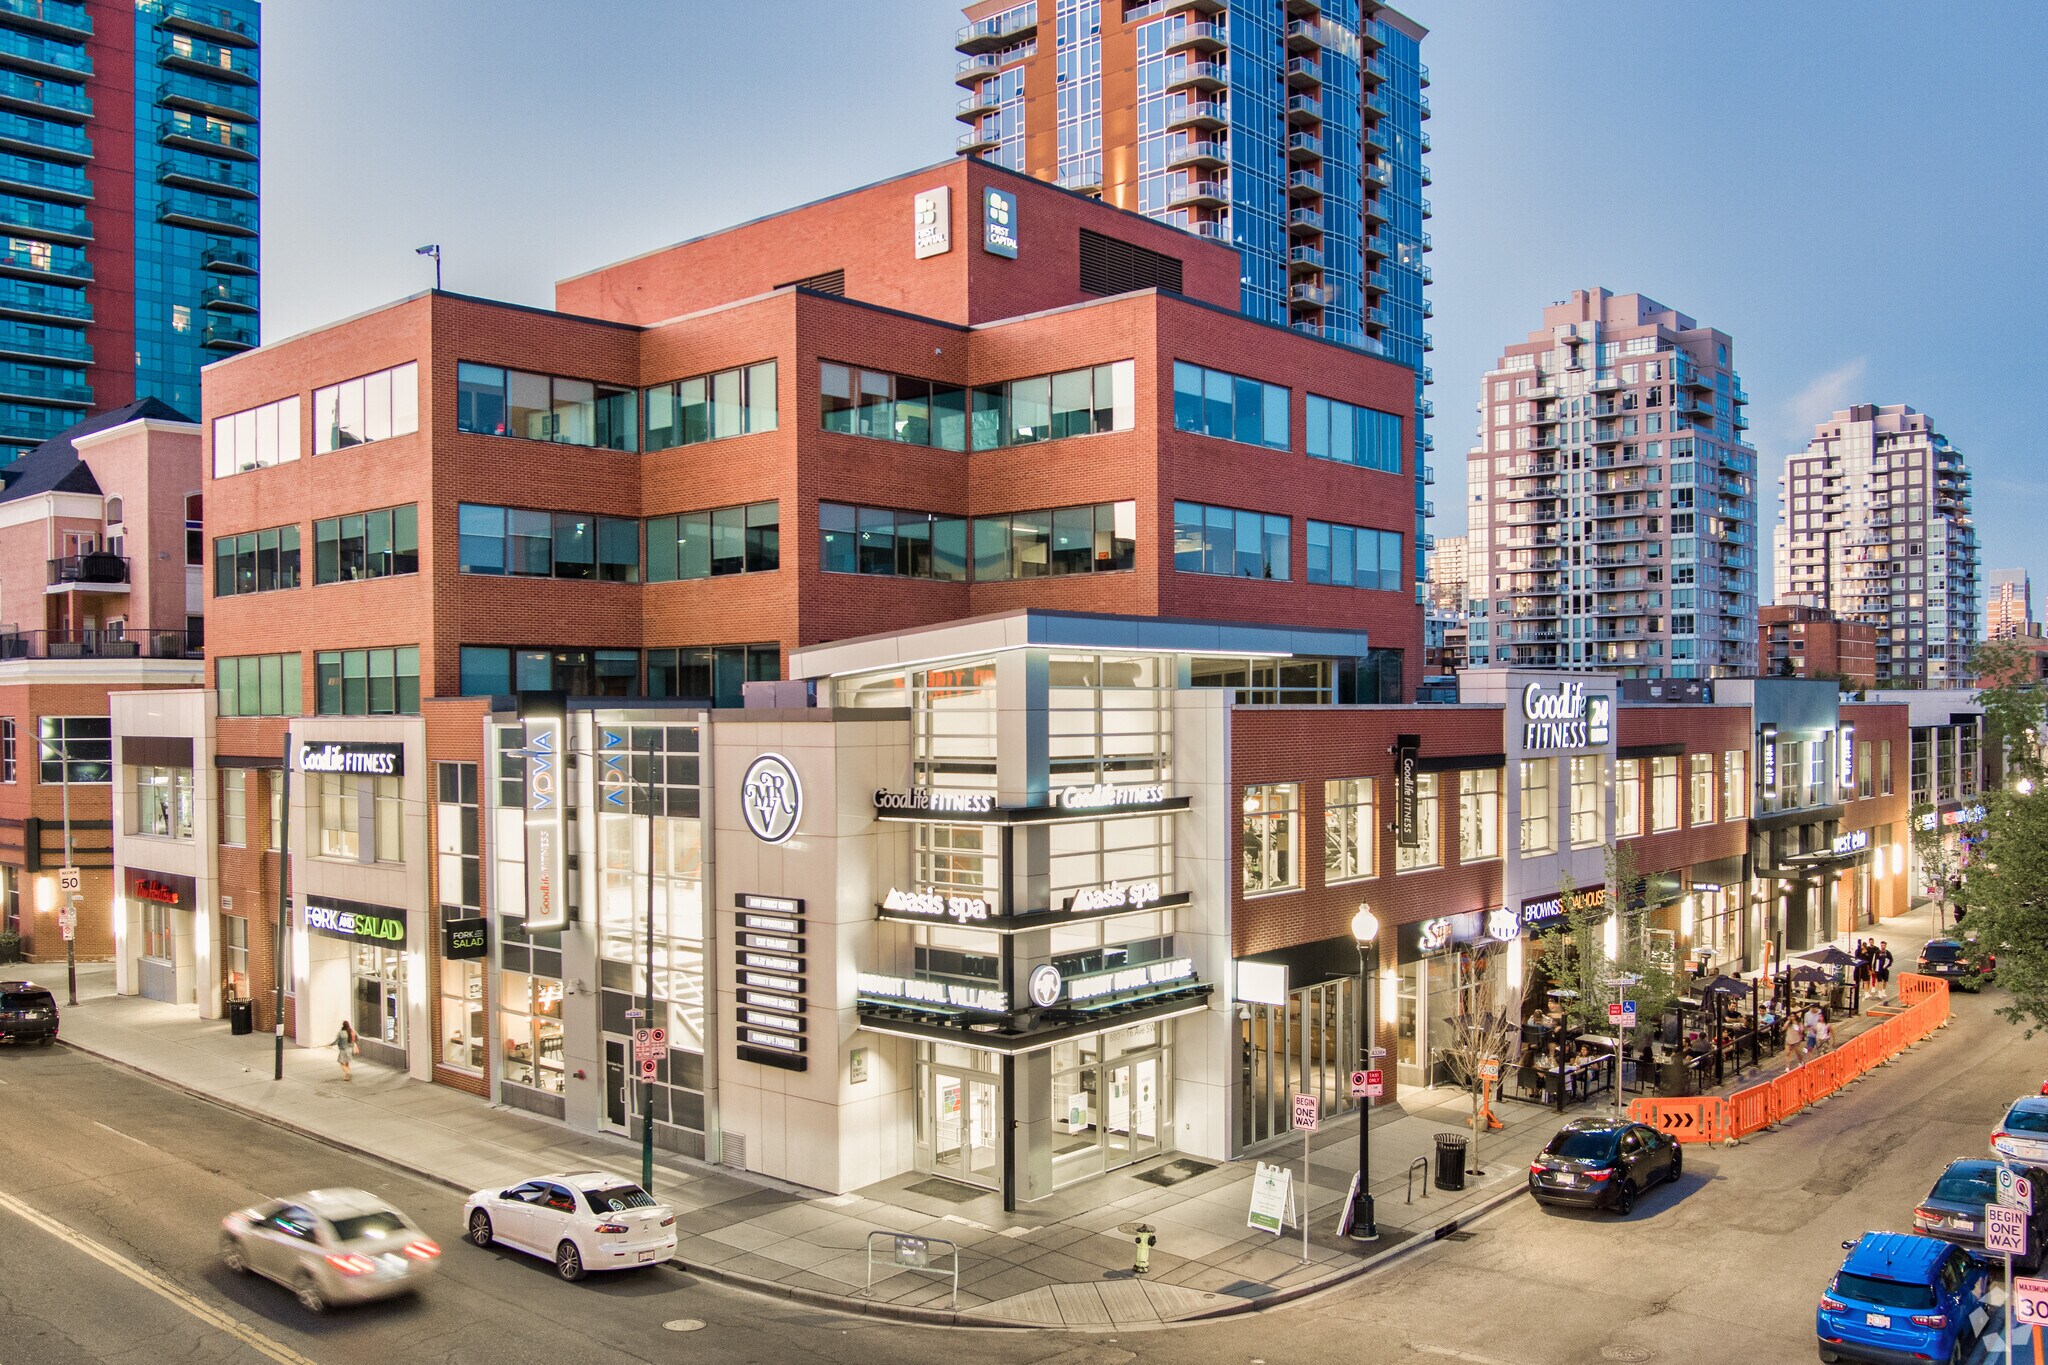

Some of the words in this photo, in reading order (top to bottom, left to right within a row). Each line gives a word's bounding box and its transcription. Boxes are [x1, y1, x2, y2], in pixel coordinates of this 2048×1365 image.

[990, 224, 1009, 236] FIRST
[990, 233, 1018, 249] CAPITAL
[1525, 682, 1586, 719] GoodLife
[1591, 701, 1608, 726] 24
[1526, 722, 1586, 749] FITNESS
[299, 745, 345, 771] GoodLife
[346, 753, 396, 773] FITNESS
[533, 731, 554, 810] VOVIA
[1404, 758, 1414, 796] GoodLife
[873, 788, 929, 809] GoodLife
[930, 794, 991, 812] FITNESS
[1062, 783, 1116, 809] GoodLife
[1115, 785, 1164, 805] FITNESS
[1404, 798, 1412, 833] FITNESS
[541, 831, 549, 871] FITNESS
[62, 878, 78, 889] 50
[1129, 883, 1159, 908] spa
[949, 896, 987, 923] spa
[1525, 899, 1559, 921] BROWNS
[304, 906, 338, 930] FORK
[355, 914, 404, 940] SALAD
[453, 931, 473, 939] FORK
[453, 938, 484, 948] SALAD
[1295, 1108, 1315, 1118] ONE
[1296, 1097, 1315, 1107] BEGIN
[1295, 1117, 1315, 1127] WAY
[1989, 1209, 2023, 1225] BEGIN
[1989, 1233, 2021, 1249] WAY
[1991, 1222, 2020, 1237] ONE
[2020, 1298, 2048, 1319] 30
